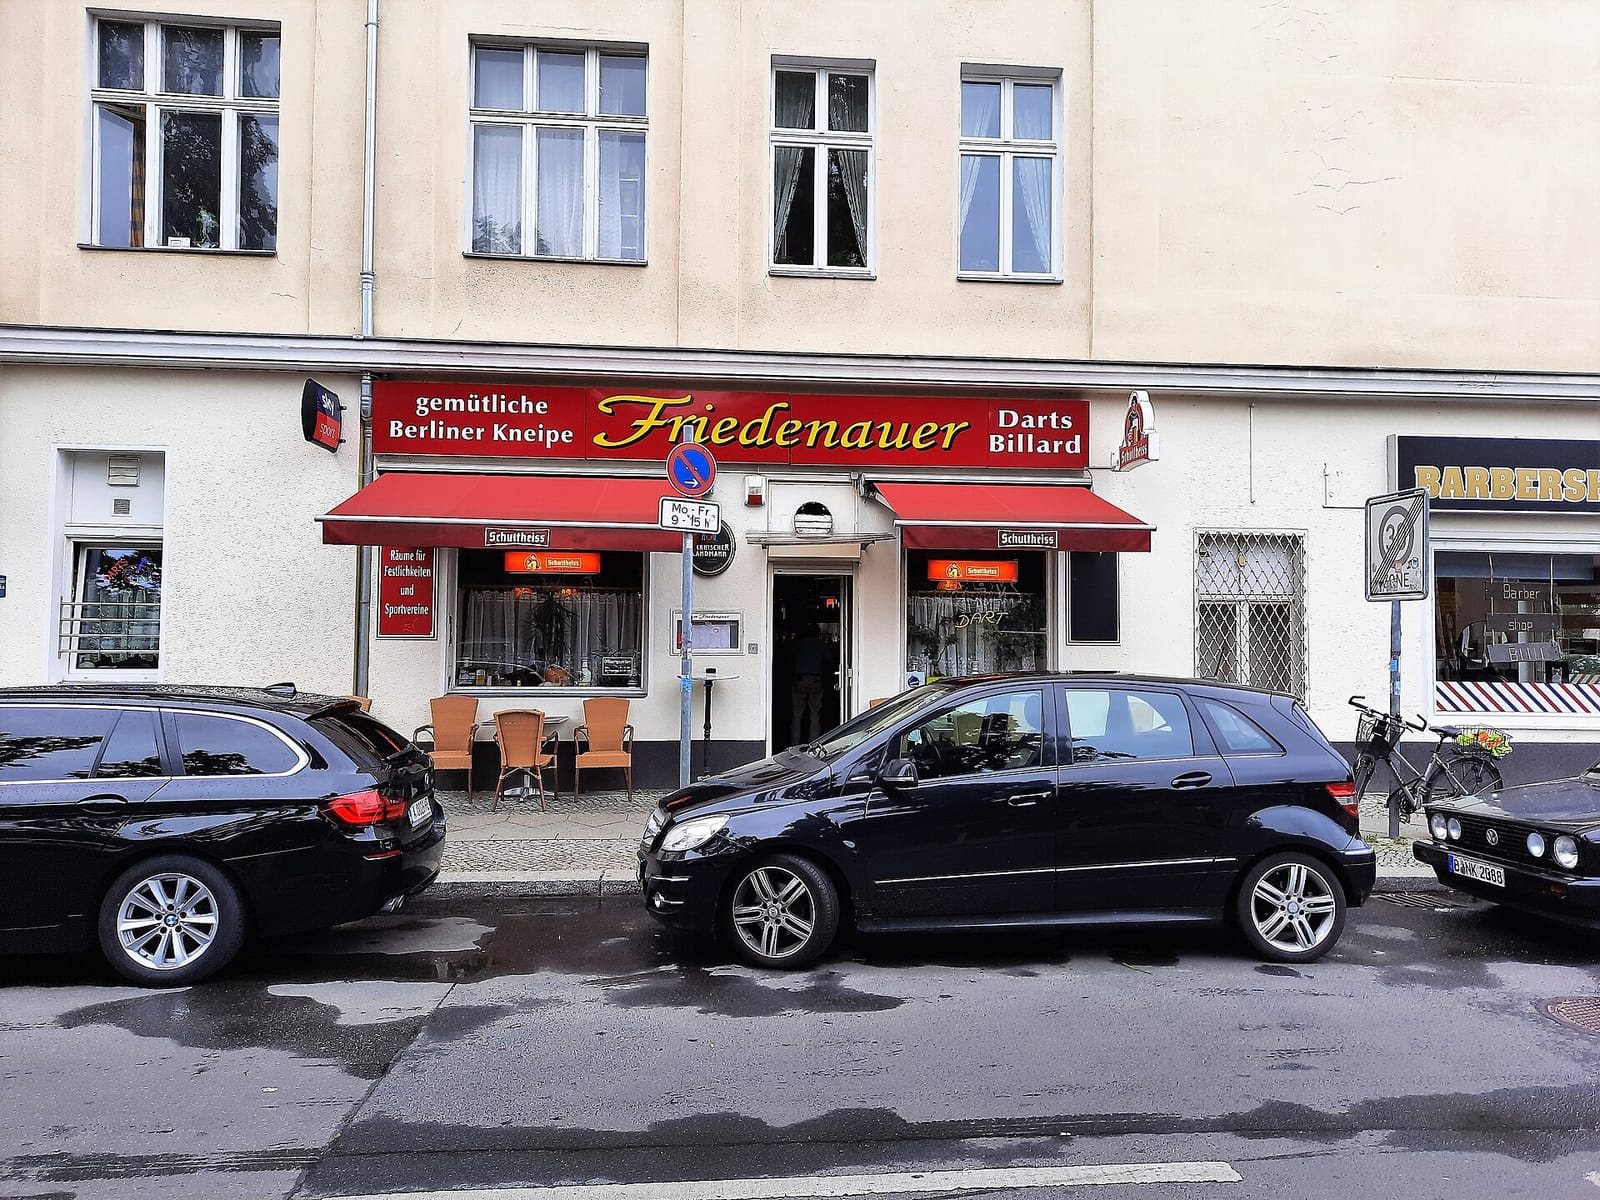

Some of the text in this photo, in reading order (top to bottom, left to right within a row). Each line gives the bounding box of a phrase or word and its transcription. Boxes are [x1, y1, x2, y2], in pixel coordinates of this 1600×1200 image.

[322, 393, 335, 417] sky
[415, 393, 548, 417] gemütliche
[593, 394, 970, 450] Friedenauer
[998, 409, 1073, 429] Darts
[320, 423, 336, 439] sport
[389, 420, 574, 449] Berliner Kneipe
[989, 433, 1081, 454] Billard
[671, 503, 688, 514] Mo
[698, 505, 710, 516] Fr
[671, 514, 679, 525] 9
[690, 514, 701, 527] 15
[489, 531, 546, 543] Schultheiss
[1001, 532, 1055, 545] Schultheiss
[390, 549, 426, 561] Räume für
[384, 564, 432, 577] Festlichkeiten
[400, 583, 415, 596] und
[1503, 583, 1540, 599] Barber
[384, 602, 429, 619] Sportvereine
[955, 610, 1009, 628] DART
[1508, 617, 1533, 632] shop
[1454, 859, 1460, 872] B
